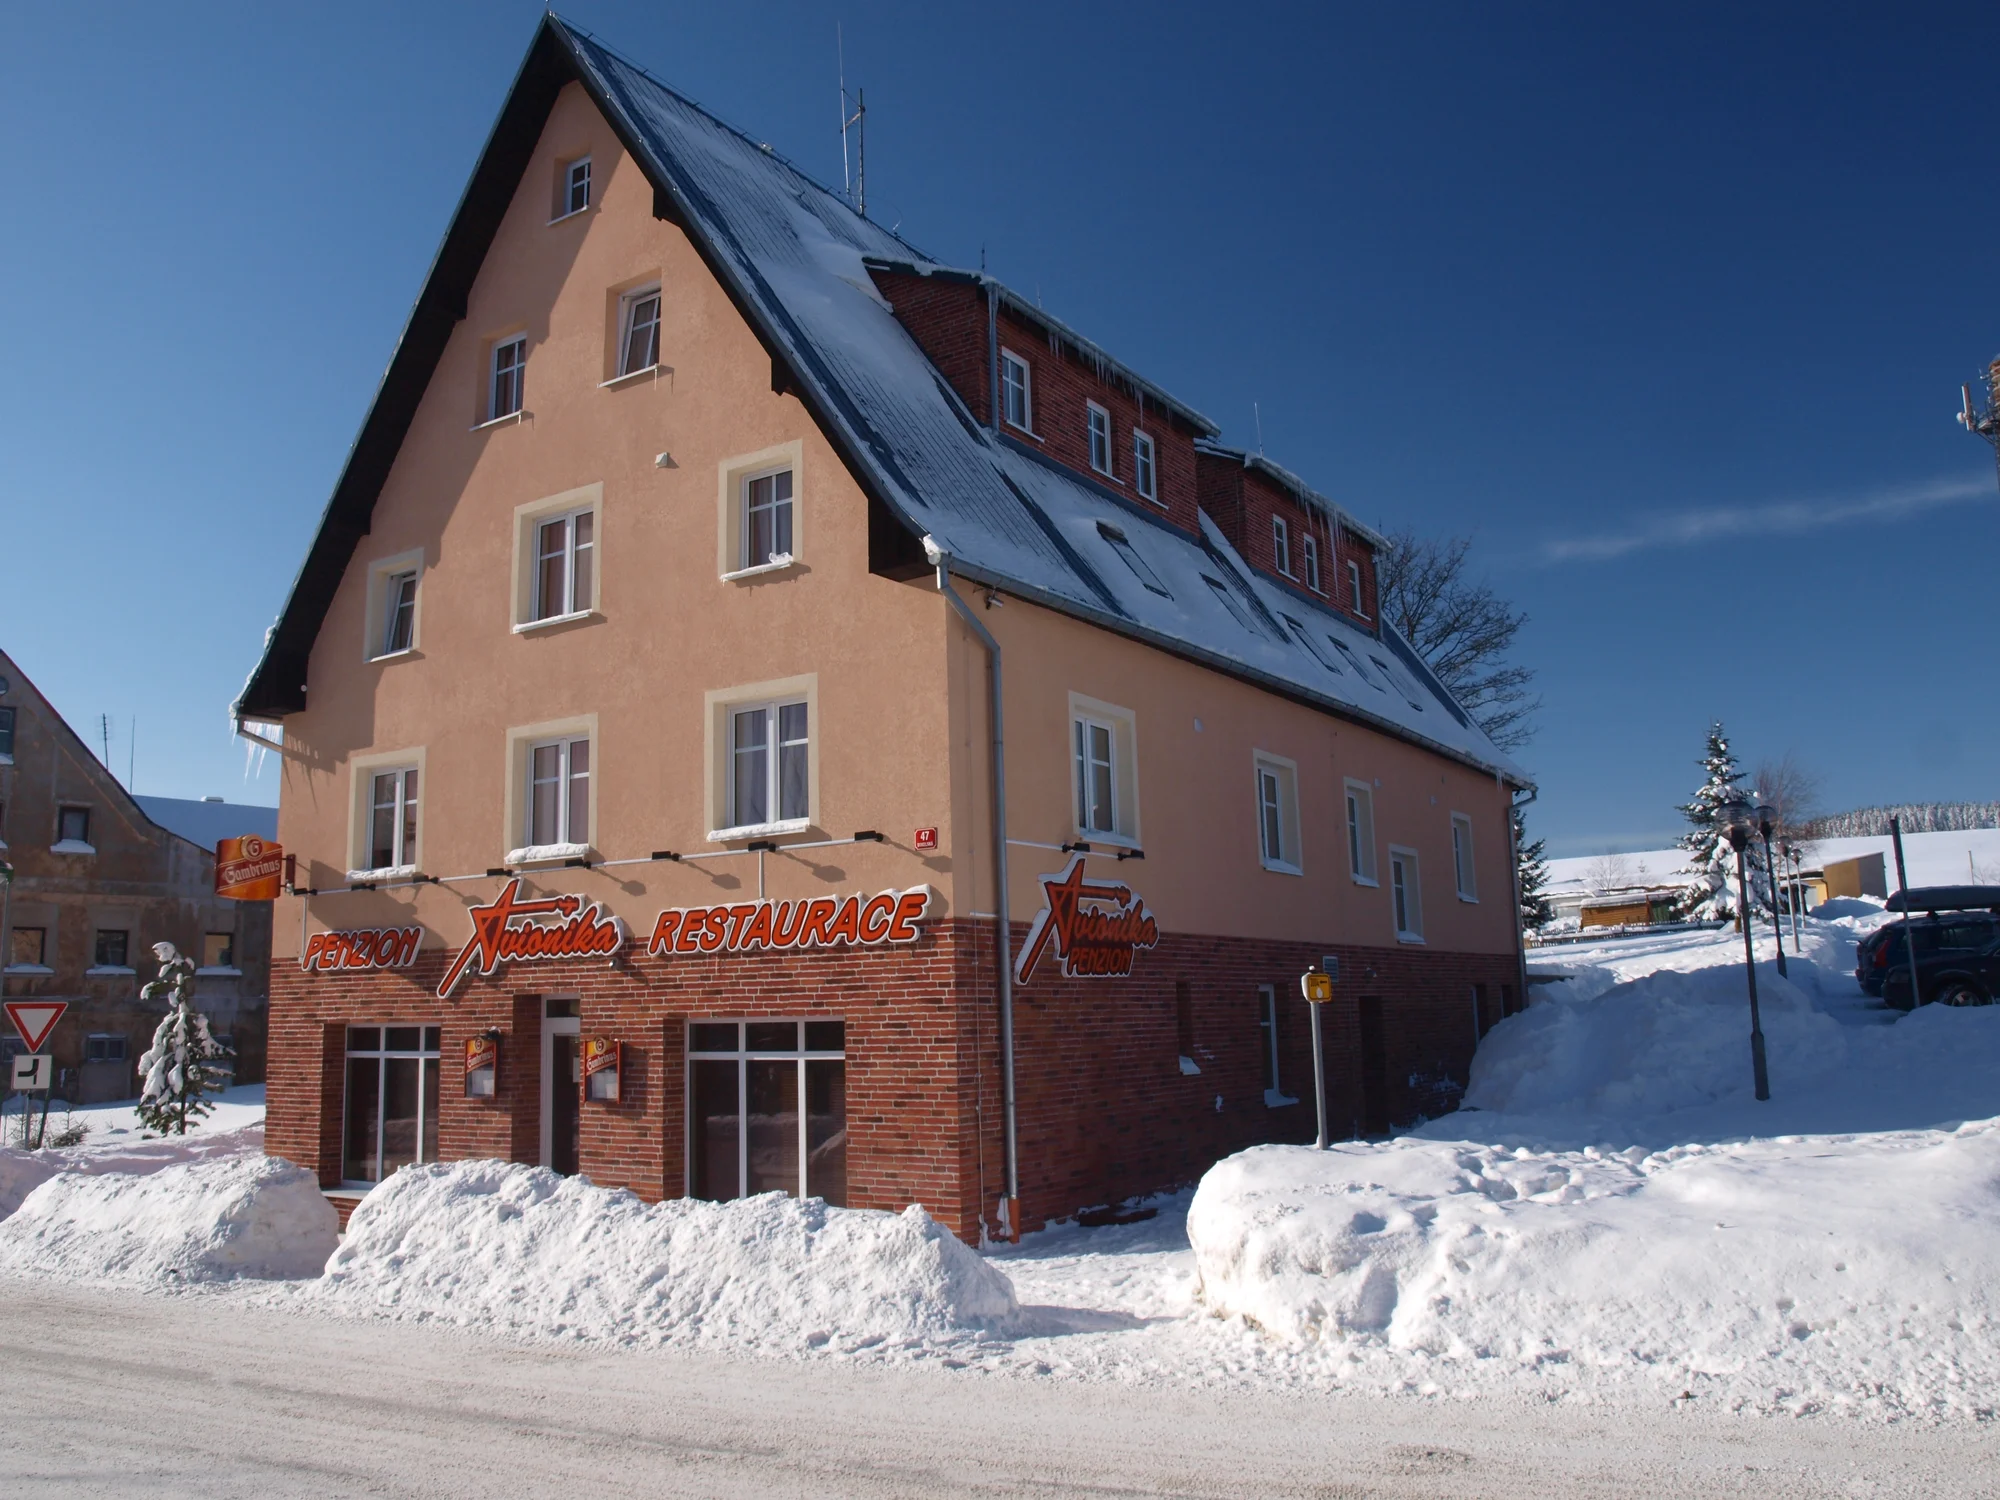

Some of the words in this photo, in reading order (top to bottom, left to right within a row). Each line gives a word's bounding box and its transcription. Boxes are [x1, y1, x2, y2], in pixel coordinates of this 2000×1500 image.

[920, 830, 930, 841] 47
[223, 859, 281, 885] Gambrinus
[438, 878, 618, 997] Avionika
[649, 892, 929, 954] RESTAURACE
[1019, 858, 1158, 983] Avionika
[302, 928, 421, 970] PENZION
[1067, 947, 1132, 975] PENZION
[586, 1052, 617, 1071] Gambrinus
